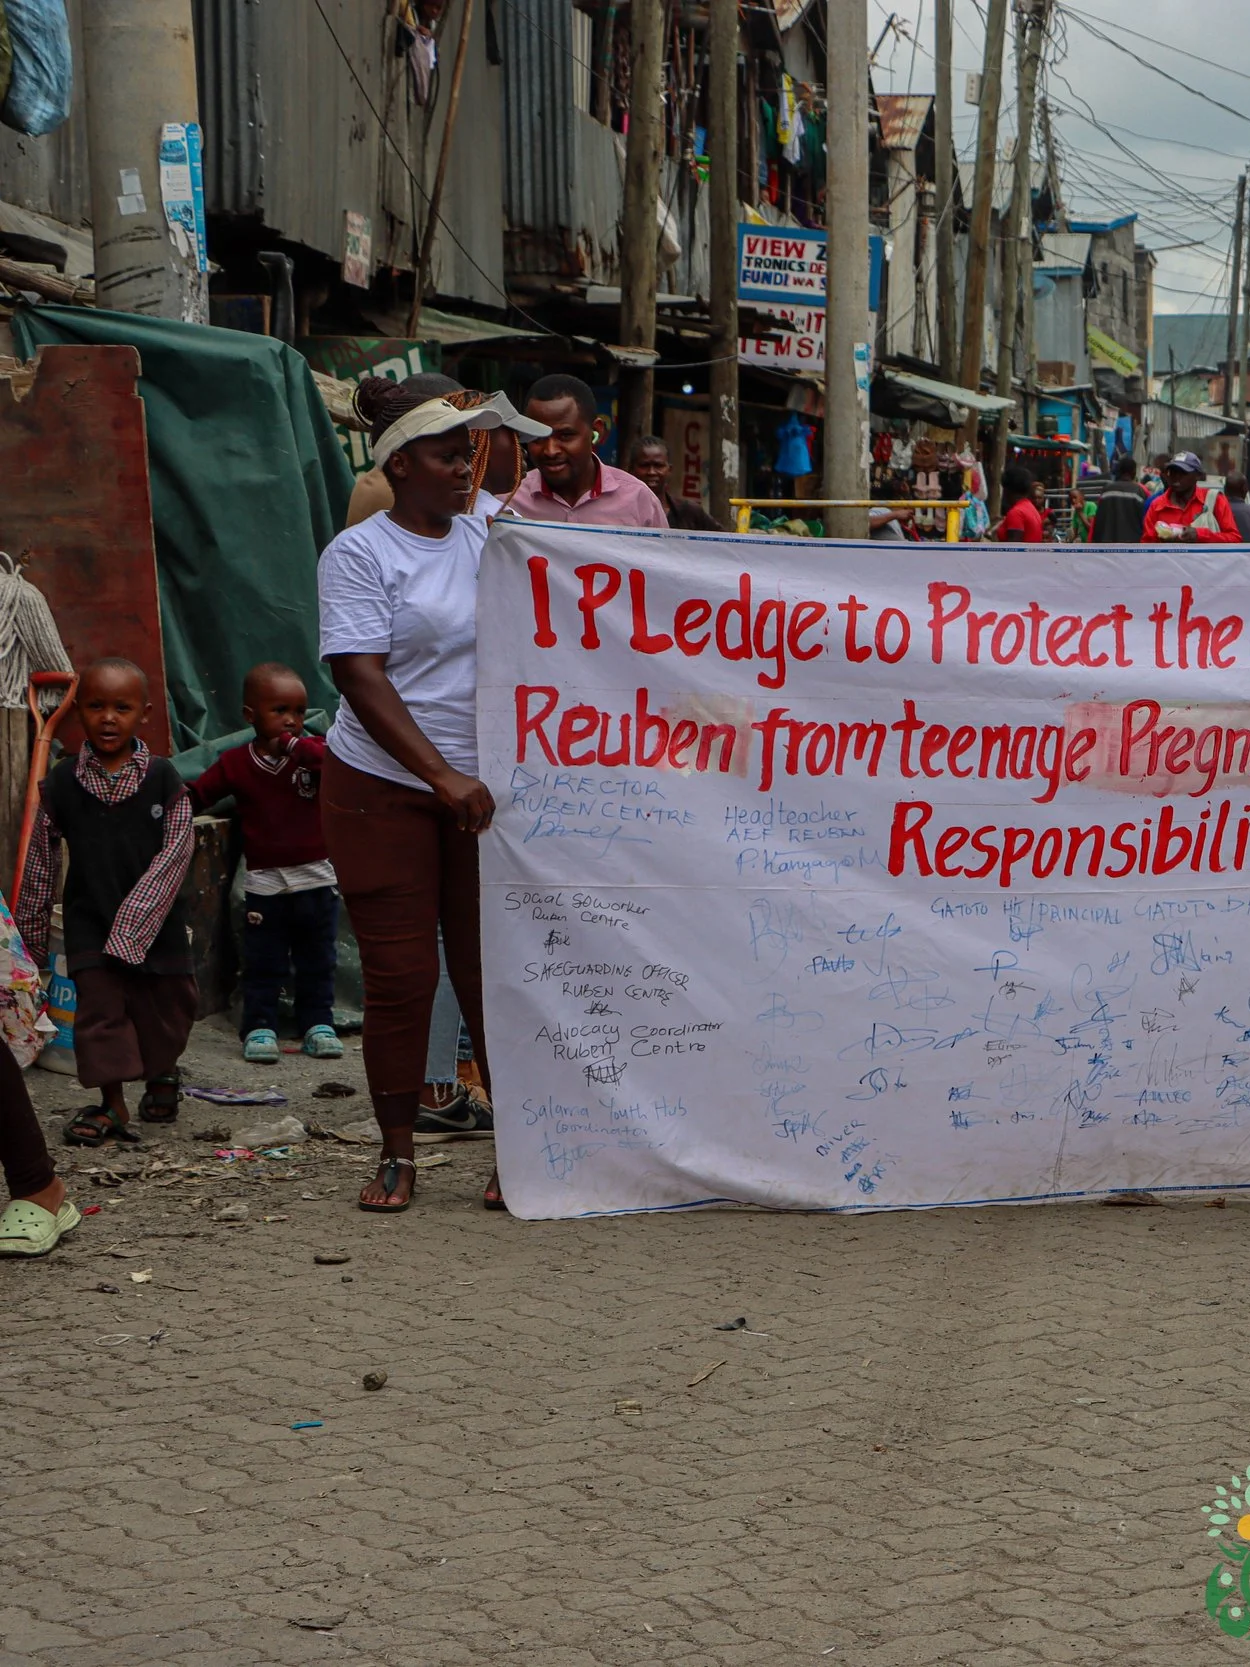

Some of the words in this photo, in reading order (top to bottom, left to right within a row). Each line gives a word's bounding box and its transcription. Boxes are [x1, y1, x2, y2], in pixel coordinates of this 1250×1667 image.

[746, 237, 806, 259] VIEW
[744, 256, 806, 273] TRONICS
[741, 269, 789, 287] FUNDI
[792, 278, 814, 288] WA
[529, 556, 558, 649] I
[838, 594, 912, 665] to
[928, 581, 1134, 667] Protect
[1150, 584, 1245, 670] the
[514, 685, 738, 774] Reuben
[752, 707, 888, 793] from
[891, 700, 1100, 804] teenage
[510, 766, 666, 800] DIRECTOR
[511, 788, 598, 816] RUBEN
[601, 801, 697, 828] CENTRE
[726, 826, 773, 843] AEF
[788, 826, 866, 843] REUBEN
[580, 910, 631, 931] Centre
[562, 982, 614, 999] RUBEN
[623, 984, 674, 1007] CENTRE
[534, 1022, 620, 1044] Advocacy
[553, 1040, 614, 1061] Ruben
[630, 1038, 707, 1057] Centre
[597, 1096, 649, 1125] Youth
[654, 1095, 689, 1121] Hub
